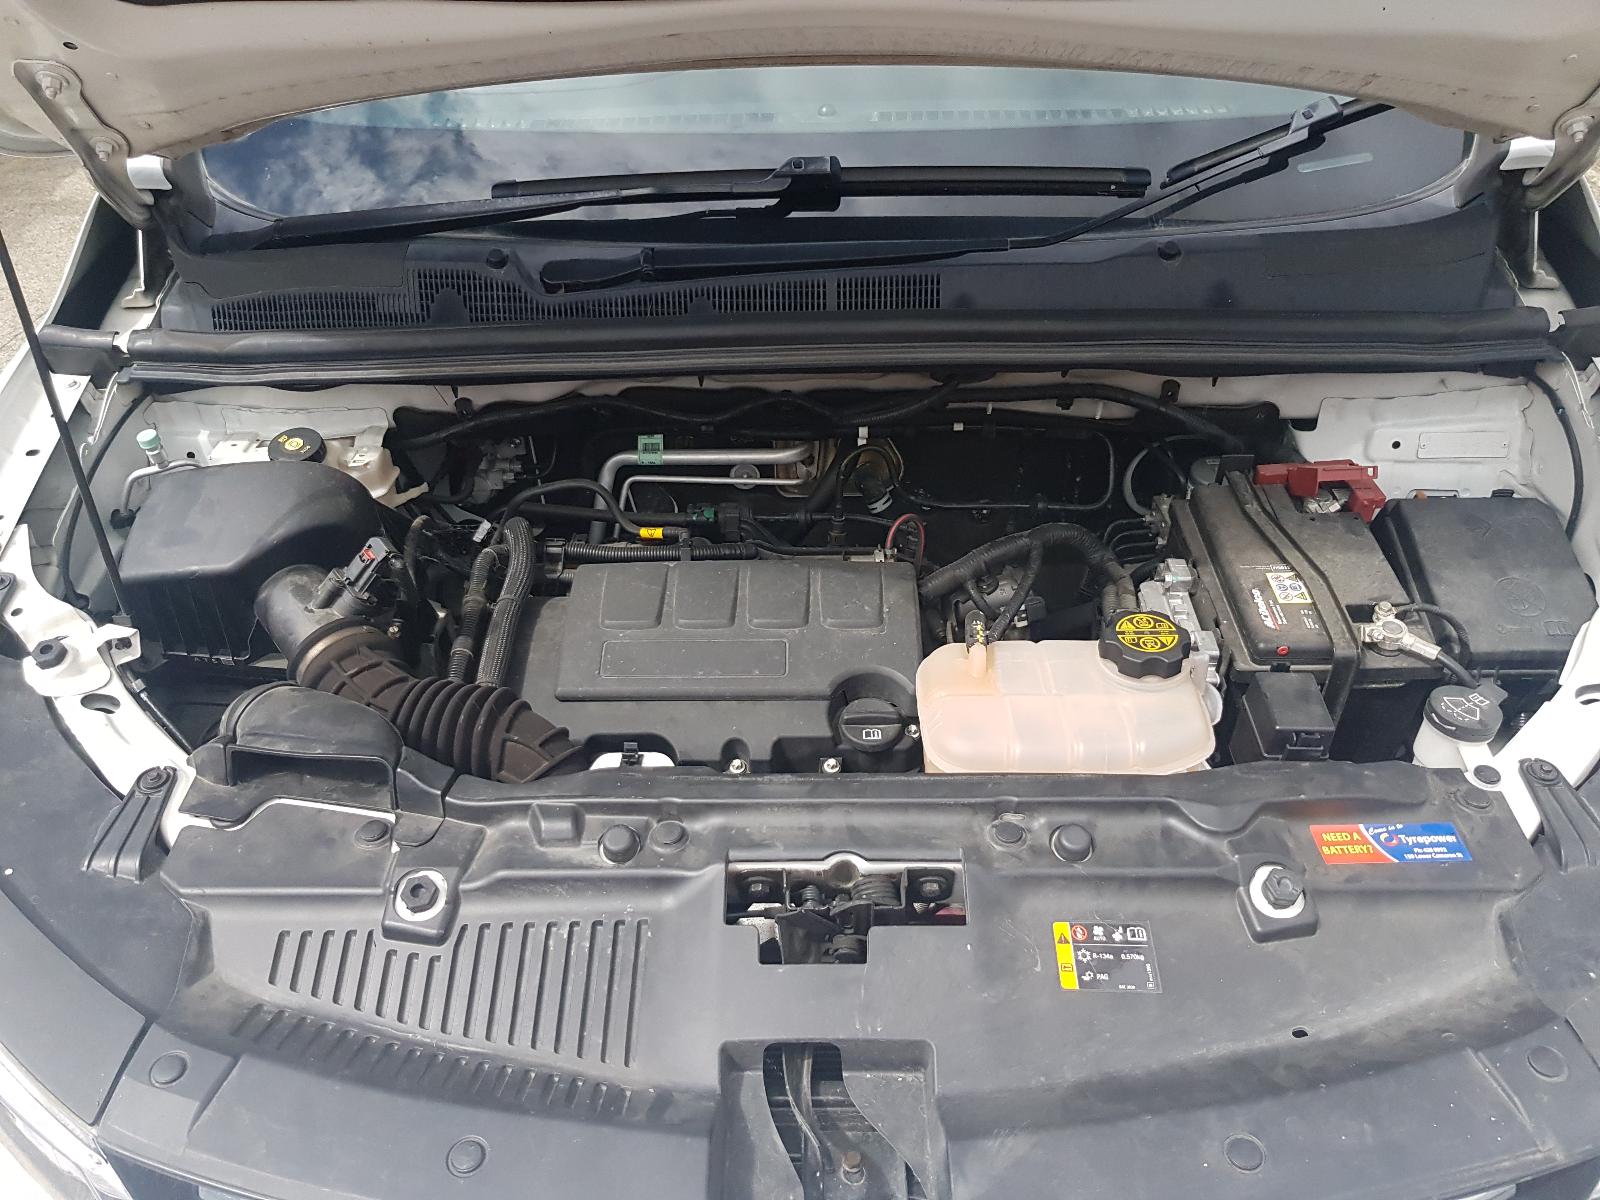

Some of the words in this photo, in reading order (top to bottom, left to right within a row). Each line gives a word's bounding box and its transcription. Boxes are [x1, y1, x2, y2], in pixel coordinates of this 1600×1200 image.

[1321, 832, 1351, 842] NEED
[1352, 832, 1362, 841] A
[1398, 834, 1457, 846] Tyrepower
[1321, 844, 1374, 855] BATTERY?
[1092, 952, 1114, 960] R-134a
[1120, 953, 1145, 961] 0.570kg
